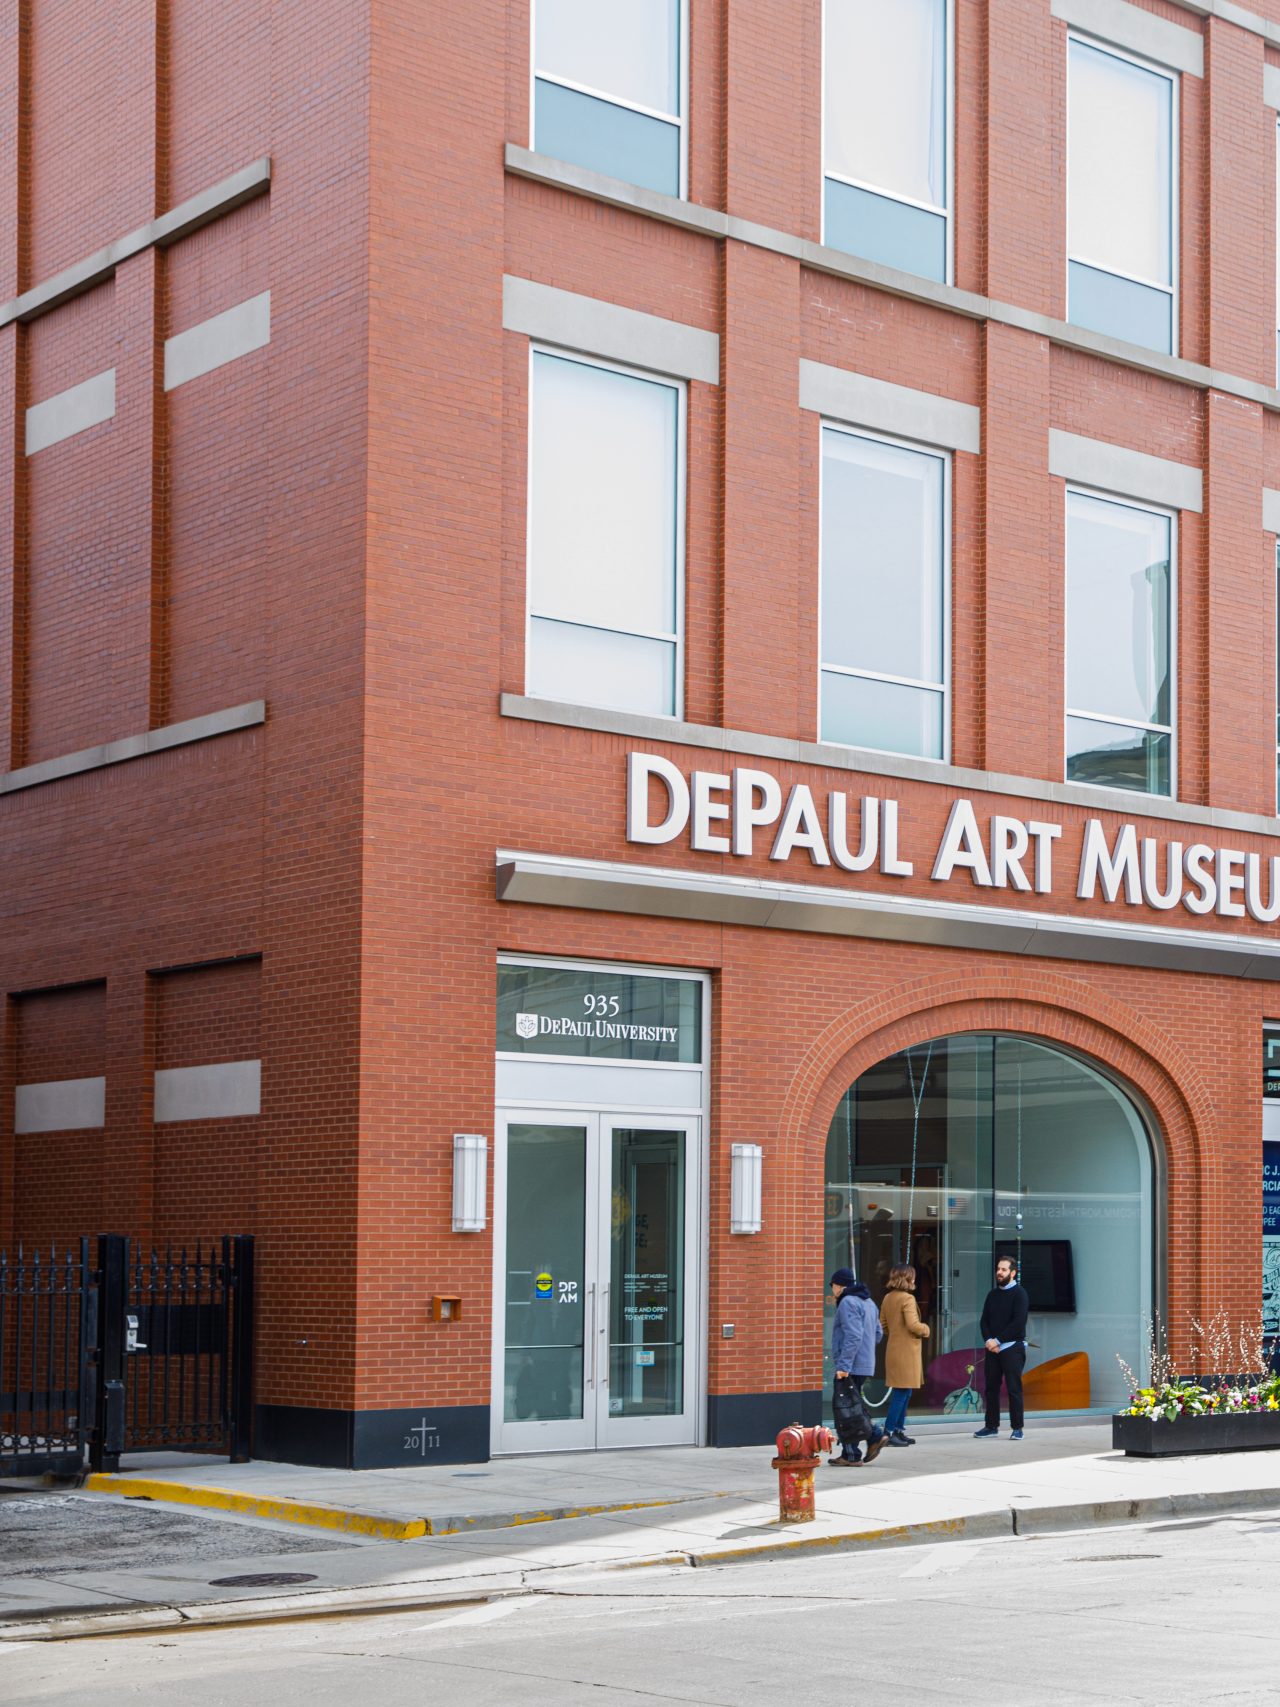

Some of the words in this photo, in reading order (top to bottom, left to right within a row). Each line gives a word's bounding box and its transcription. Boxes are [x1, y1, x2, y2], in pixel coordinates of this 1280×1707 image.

[583, 993, 620, 1017] 935
[559, 1282, 577, 1292] DP
[559, 1293, 577, 1303] AM
